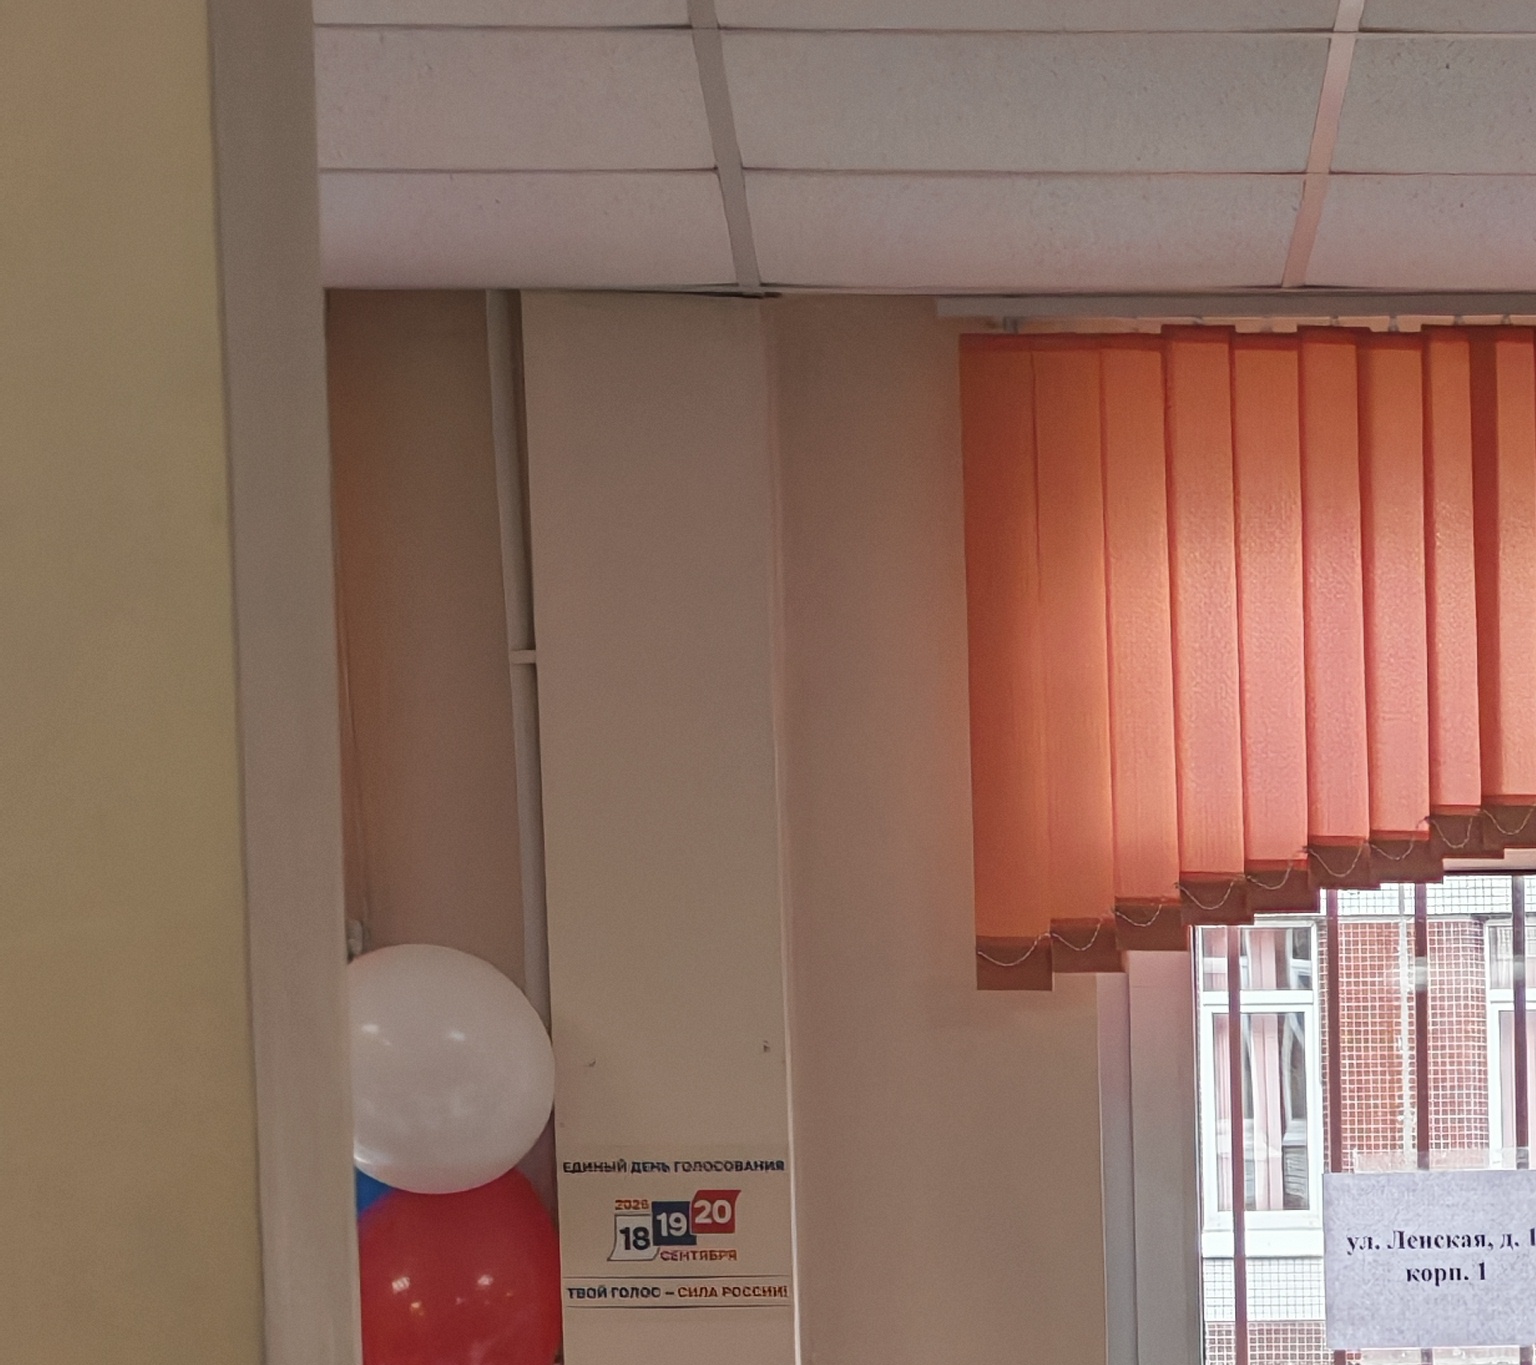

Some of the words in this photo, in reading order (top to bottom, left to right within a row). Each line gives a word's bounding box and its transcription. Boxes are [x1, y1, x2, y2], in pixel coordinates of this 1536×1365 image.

[563, 1159, 627, 1173] ЕДИНЫЙ
[631, 1161, 670, 1173] ДЕНЬ
[674, 1160, 785, 1172] ГОЛОСОВАНИЯ
[615, 1199, 650, 1210] 2026
[619, 1226, 650, 1250] 18
[657, 1212, 688, 1237] 19
[694, 1199, 732, 1224] 20
[1347, 1235, 1380, 1255] ул.
[1387, 1230, 1493, 1250] Ленская,
[1500, 1232, 1519, 1249] д.
[660, 1250, 737, 1261] СЕНТЯБРЯ
[1406, 1266, 1469, 1286] корп.
[1478, 1262, 1486, 1280] 1
[567, 1286, 607, 1299] ТВОЙ
[611, 1287, 661, 1298] ГОЛОС
[677, 1286, 718, 1298] СИЛА
[722, 1285, 788, 1297] РОССИИ!
